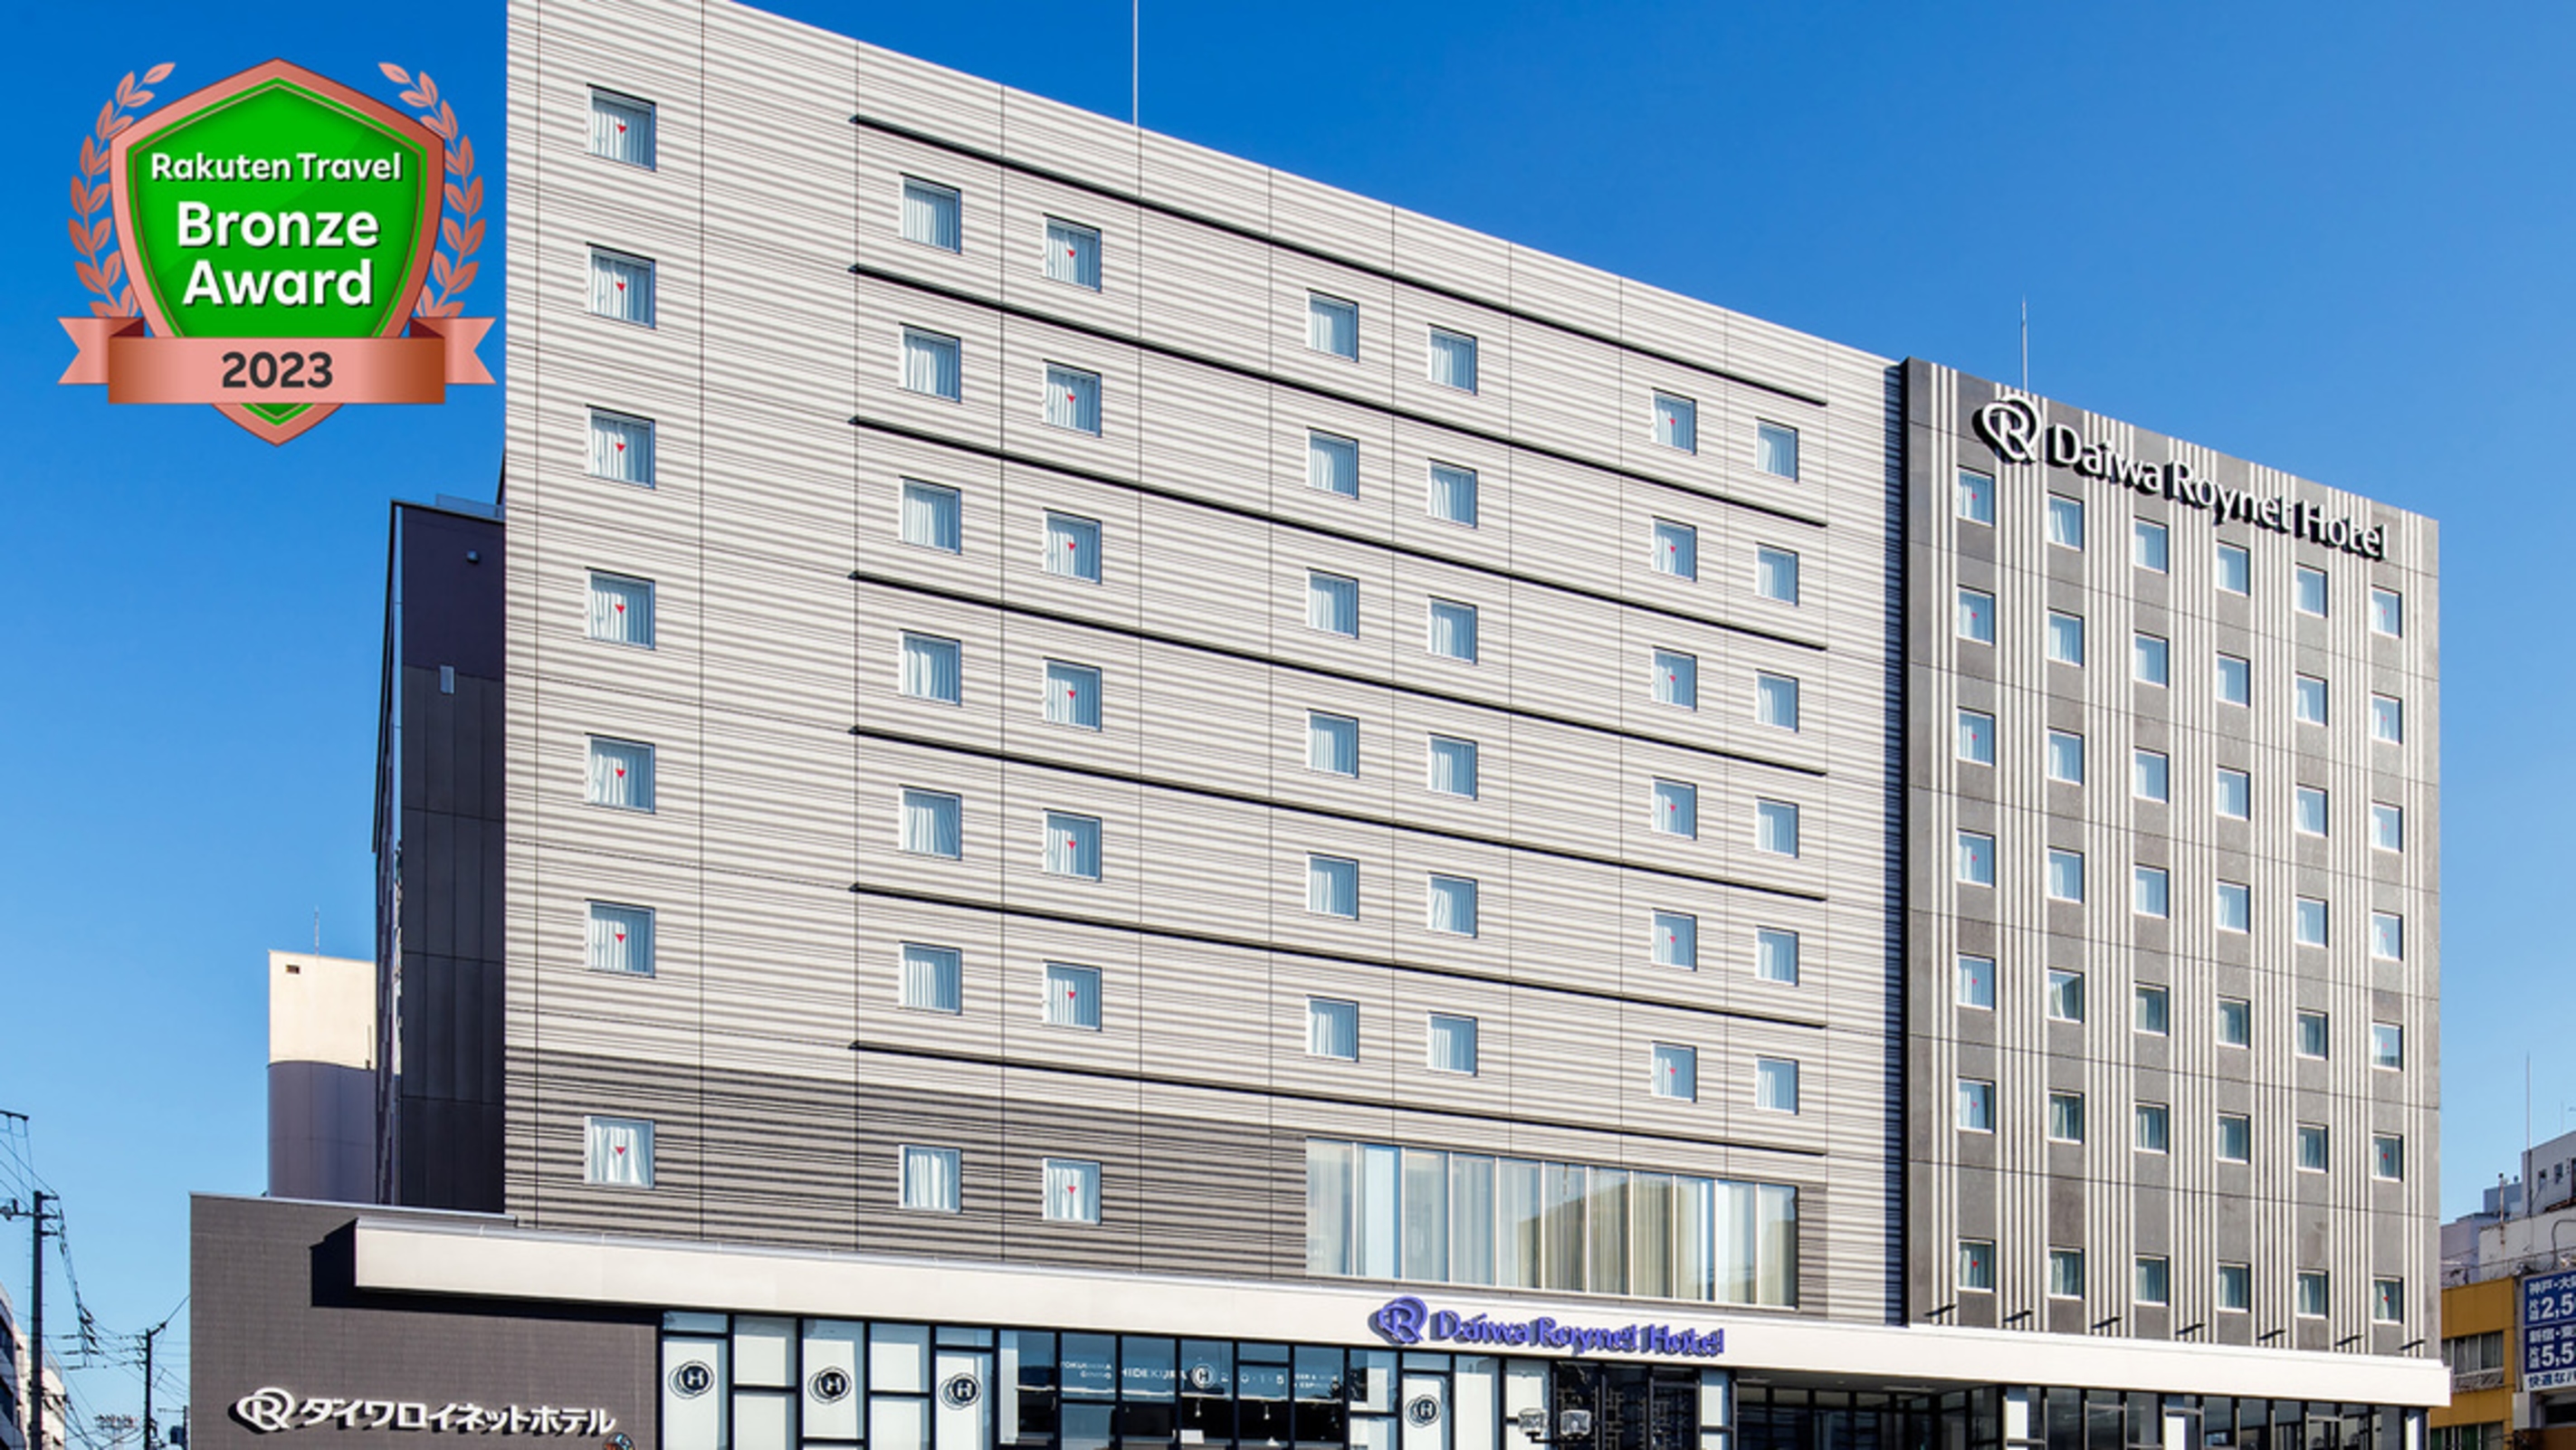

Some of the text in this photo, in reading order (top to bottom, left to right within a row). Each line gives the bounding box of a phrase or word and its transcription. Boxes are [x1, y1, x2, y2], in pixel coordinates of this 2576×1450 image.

[2051, 424, 2388, 559] Daiwa Roynet Hotel
[2542, 1293, 2576, 1320] 2,5
[1437, 1310, 1725, 1356] Daiwa Roynet Hotel
[2529, 1325, 2576, 1343] 新宿・東
[2542, 1341, 2576, 1368] 5,5
[300, 1397, 617, 1436] ダイワロイネットホテル
